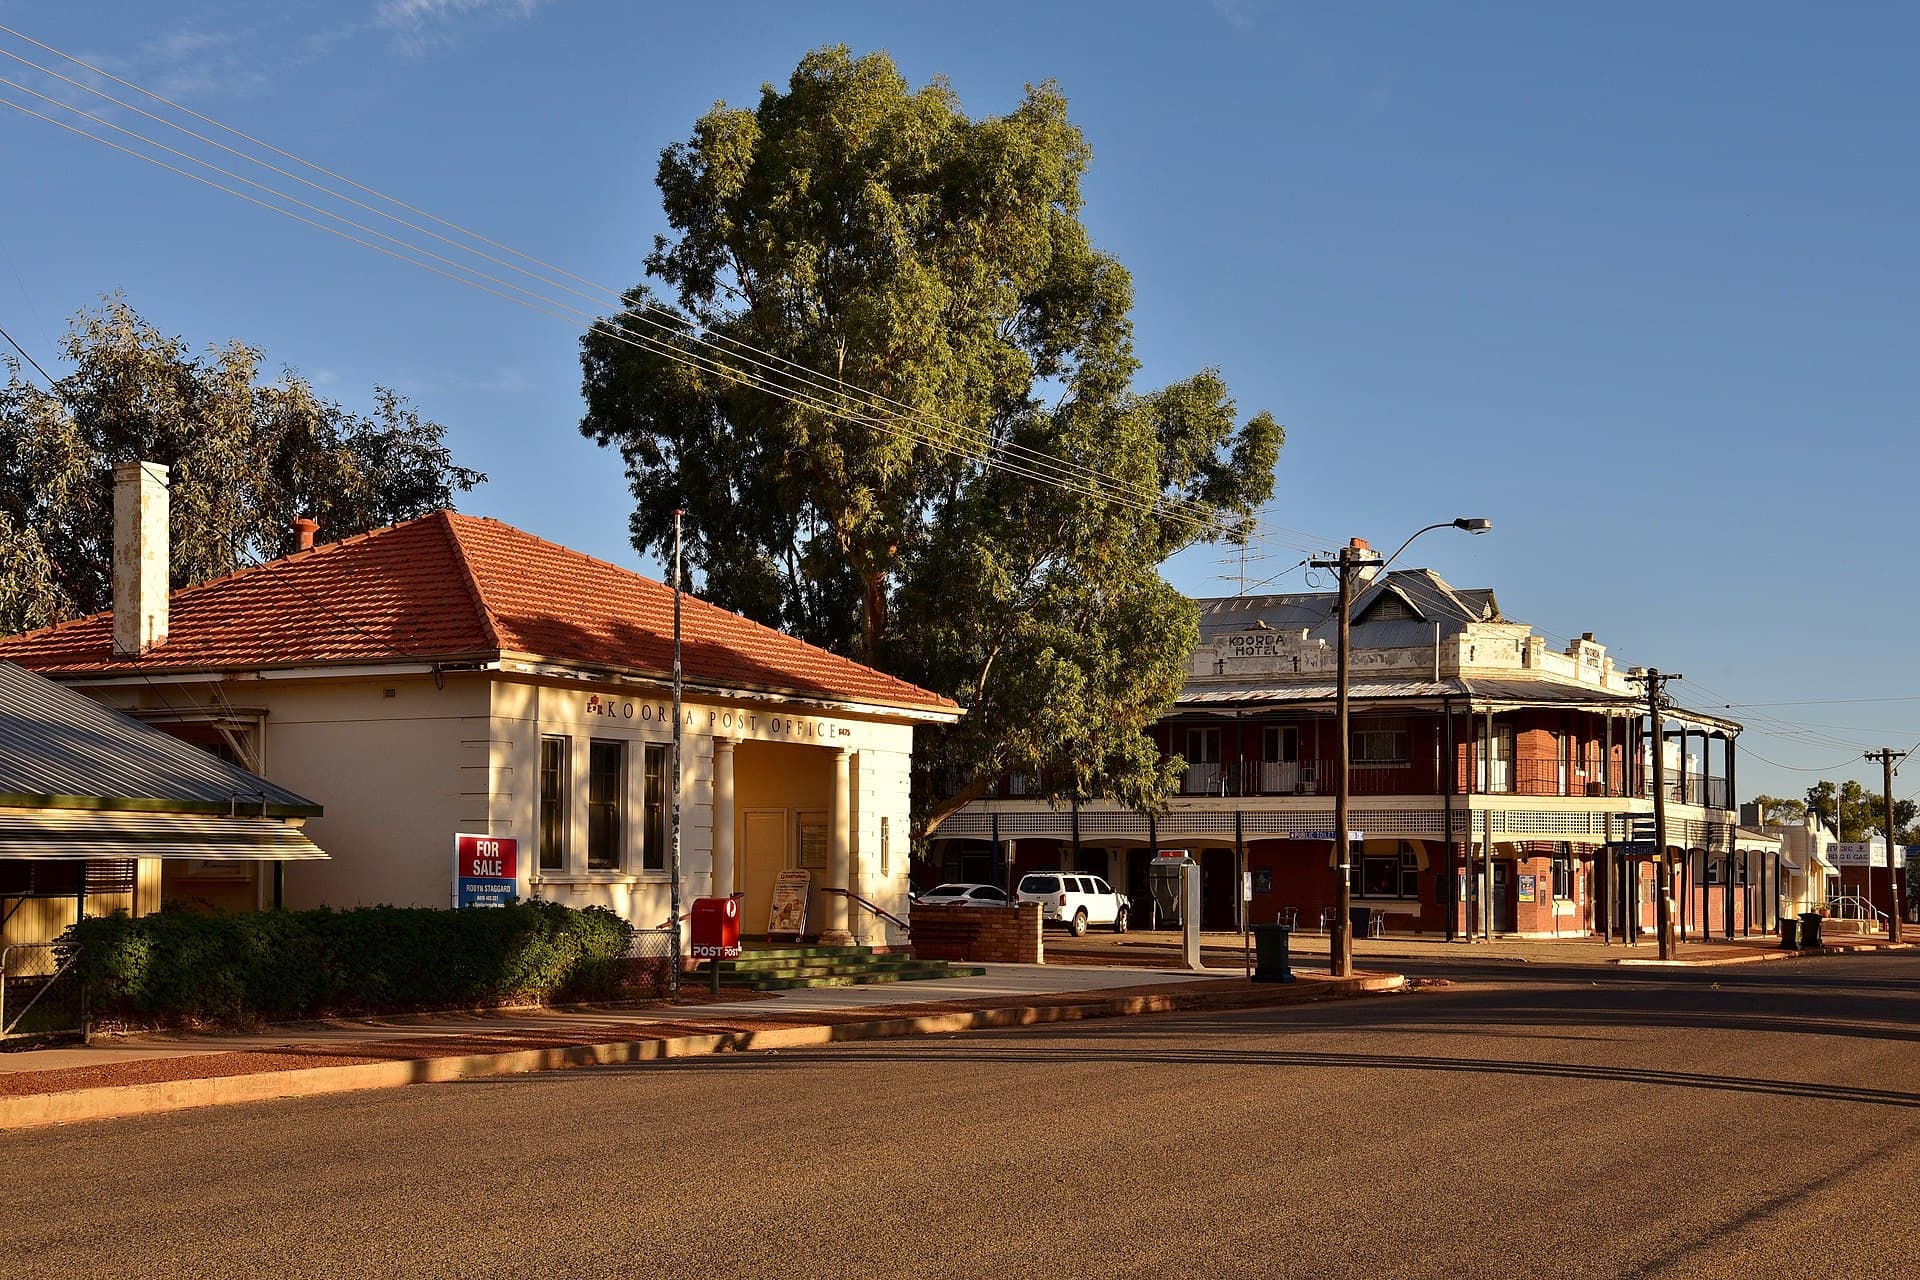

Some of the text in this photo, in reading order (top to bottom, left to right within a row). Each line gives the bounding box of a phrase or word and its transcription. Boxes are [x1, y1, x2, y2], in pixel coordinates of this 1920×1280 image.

[1229, 635, 1285, 646] KOORDA
[1235, 646, 1279, 656] HOTEL
[607, 701, 836, 739] KOORA POST OFFICE
[476, 840, 499, 857] FOR
[473, 859, 502, 876] SALE
[693, 946, 723, 956] POST
[724, 948, 738, 956] POST
